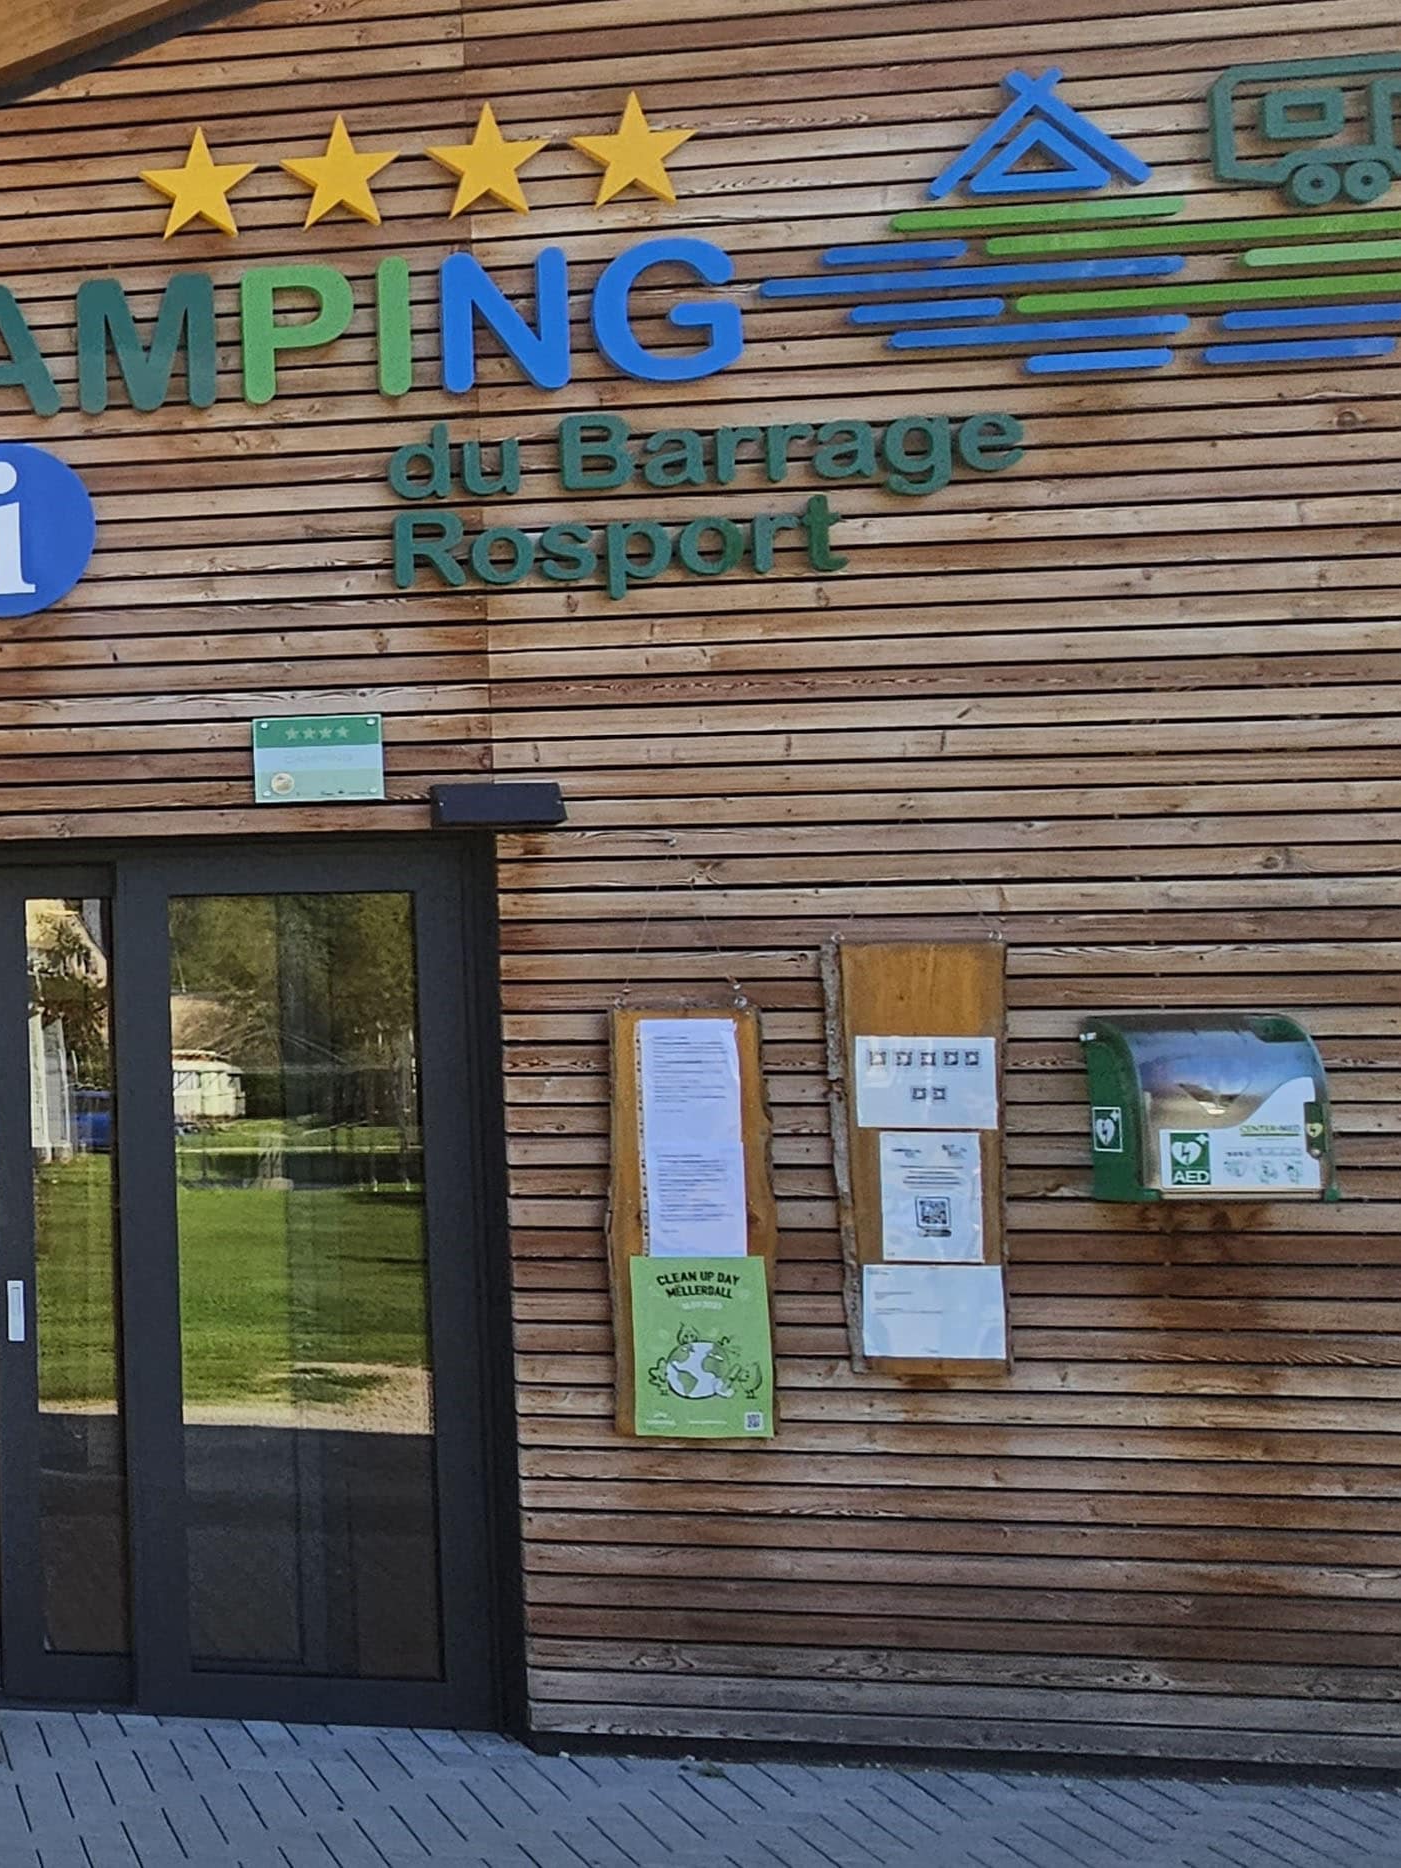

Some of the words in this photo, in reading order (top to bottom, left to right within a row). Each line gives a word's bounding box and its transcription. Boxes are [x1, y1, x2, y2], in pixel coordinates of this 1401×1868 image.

[389, 422, 521, 499] du
[559, 412, 1025, 496] Barrage
[392, 493, 849, 601] Rosport
[1173, 1170, 1209, 1184] AED
[656, 1271, 697, 1286] CLEAN
[699, 1270, 715, 1281] UP
[717, 1271, 741, 1286] DAY
